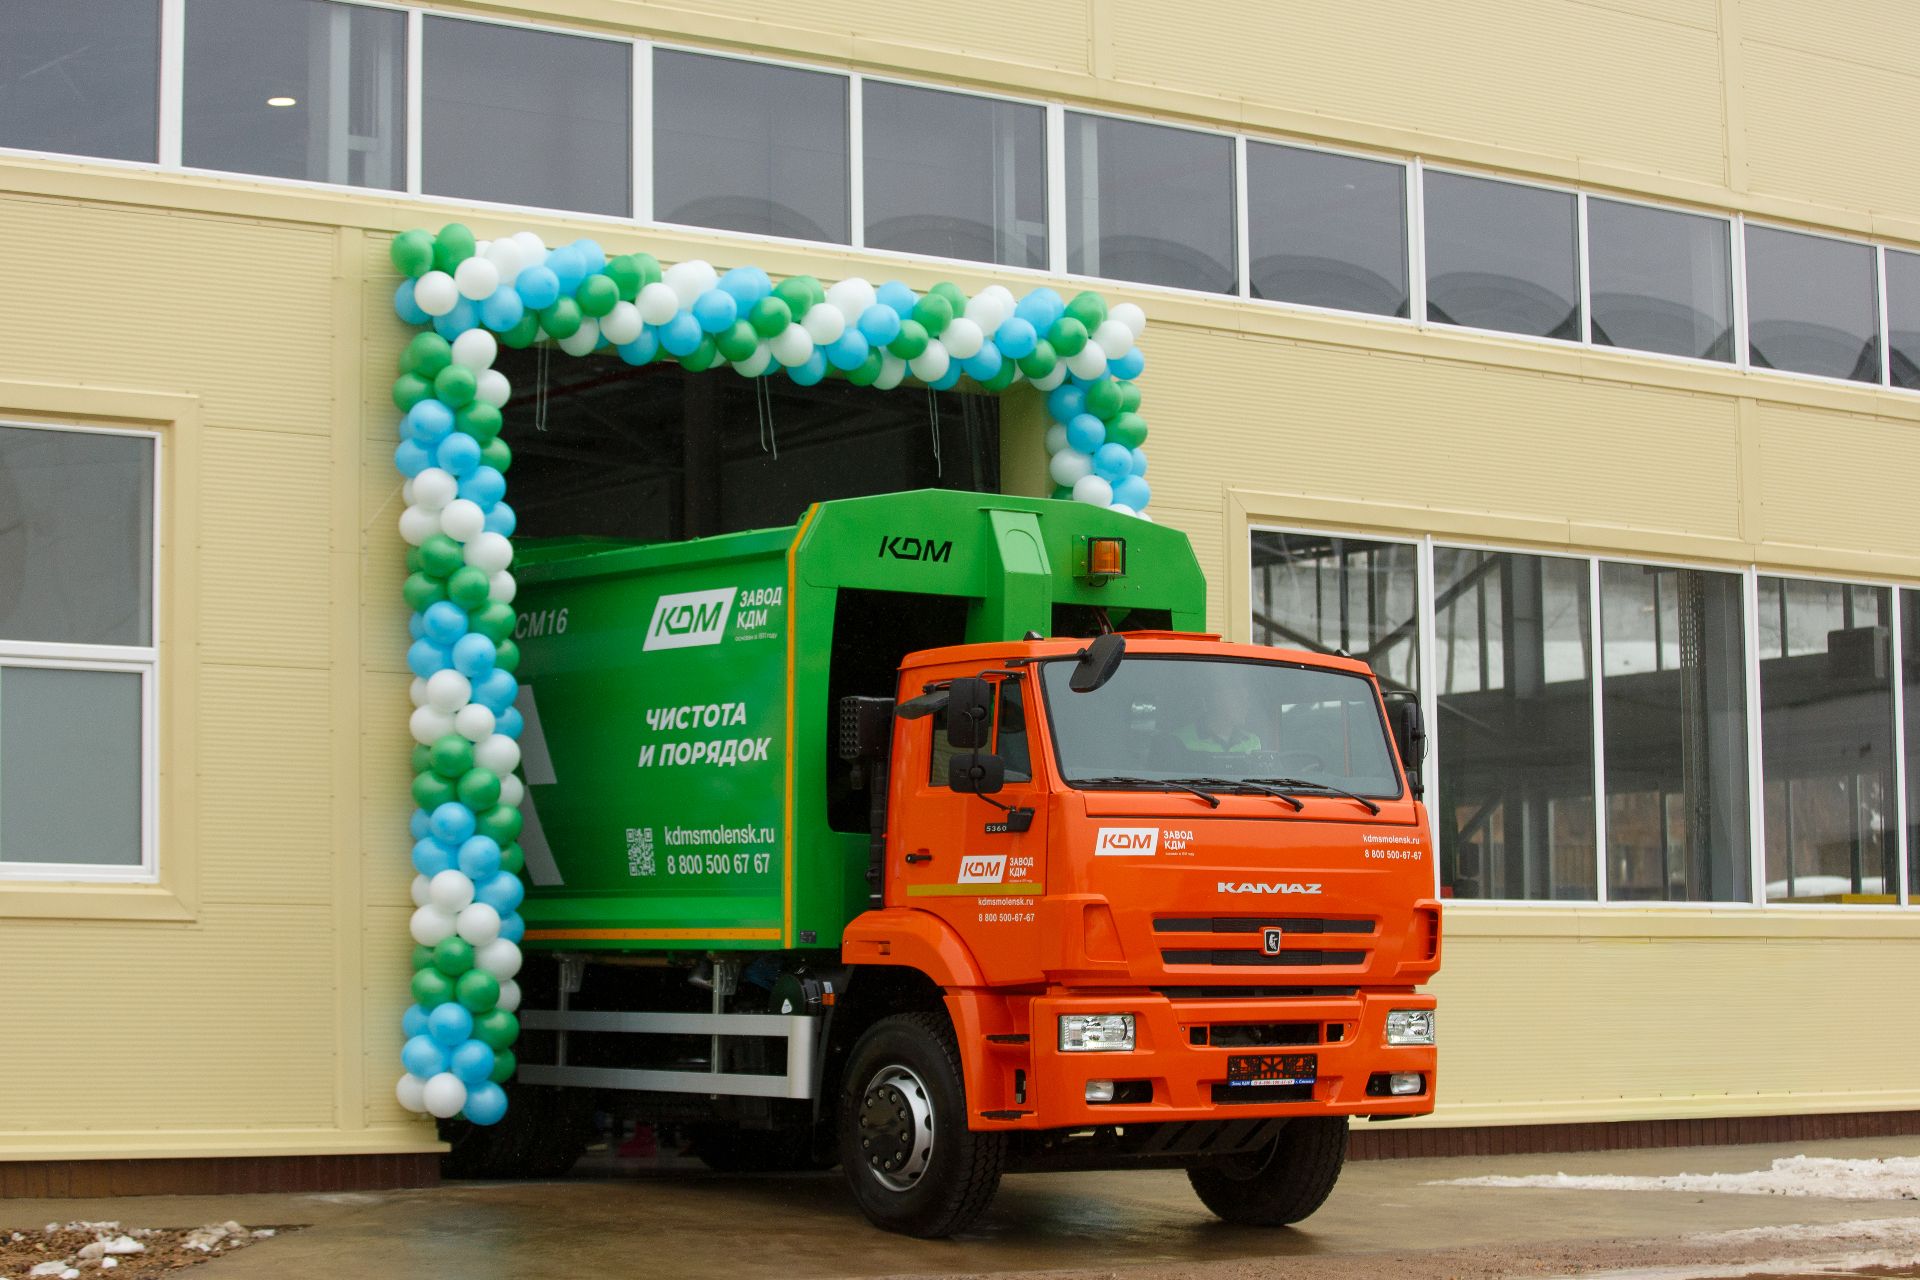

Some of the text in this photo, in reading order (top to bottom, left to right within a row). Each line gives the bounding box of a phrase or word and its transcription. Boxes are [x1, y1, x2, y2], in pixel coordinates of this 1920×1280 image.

[878, 535, 953, 563] KDM
[740, 586, 783, 608] ЗАВОД
[654, 601, 724, 637] KDM
[736, 609, 768, 630] КДМ
[646, 702, 747, 731] ЧИСТОТА
[638, 737, 772, 767] И ПОРЯДОК
[664, 824, 775, 845] kdmsmolensk.ru
[1103, 834, 1152, 849] KDM
[1163, 830, 1194, 840] ЗАВОД
[1362, 834, 1420, 844] kdmsmolensk.ru
[1164, 841, 1186, 850] КДМ
[1365, 849, 1370, 858] 8
[1371, 849, 1385, 859] 800
[667, 853, 770, 874] 8 800 500 67 67
[963, 862, 1000, 877] KDM
[1009, 857, 1034, 867] ЗАВОД
[1009, 867, 1027, 877] КДМ
[1217, 882, 1322, 894] KAMAZ
[978, 897, 1034, 906] kdmsmolensk.ru
[978, 913, 983, 922] 8
[985, 913, 997, 922] 800
